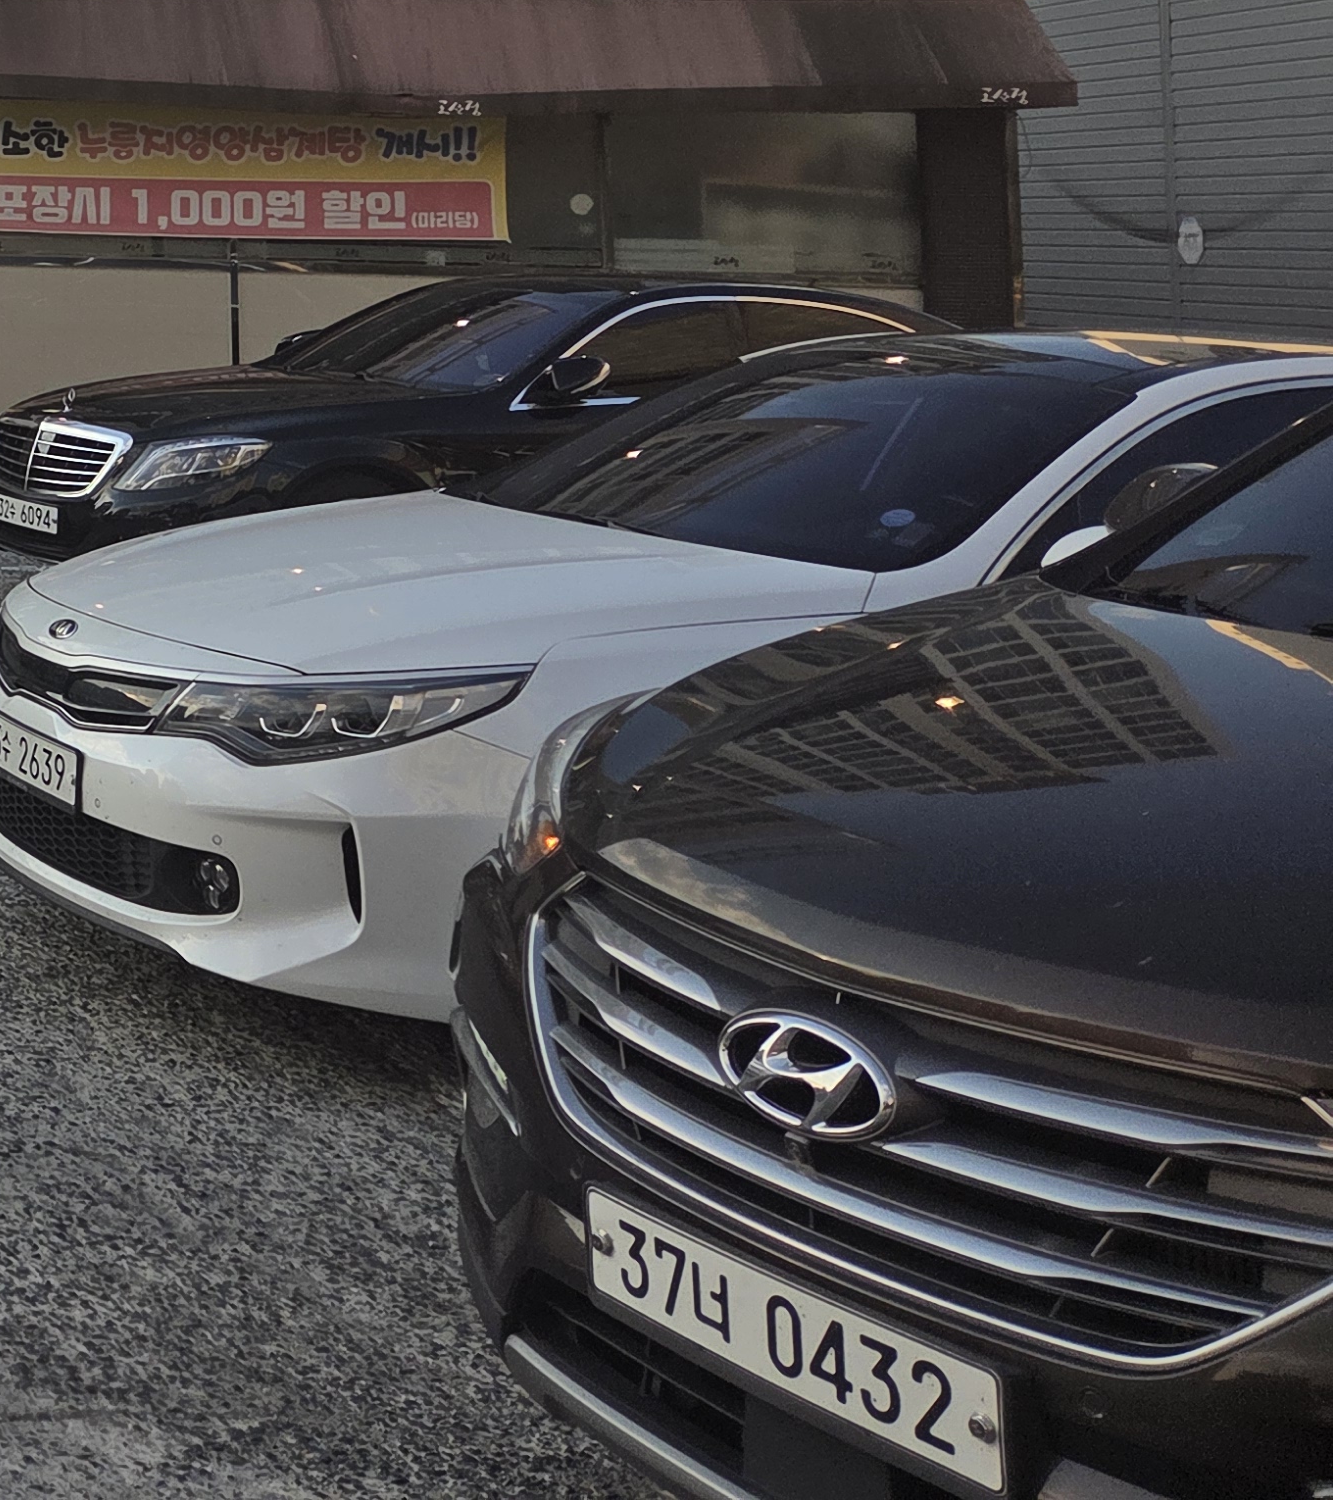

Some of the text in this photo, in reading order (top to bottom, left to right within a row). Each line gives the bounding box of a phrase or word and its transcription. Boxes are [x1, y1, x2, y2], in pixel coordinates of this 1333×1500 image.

[375, 125, 479, 163] 개시!!
[130, 187, 306, 231] 1,000원
[321, 189, 407, 230] 할인
[410, 210, 480, 229] (마리당)
[20, 504, 51, 529] 6094
[18, 736, 66, 790] 2639
[618, 1219, 956, 1456] 37너 0432
